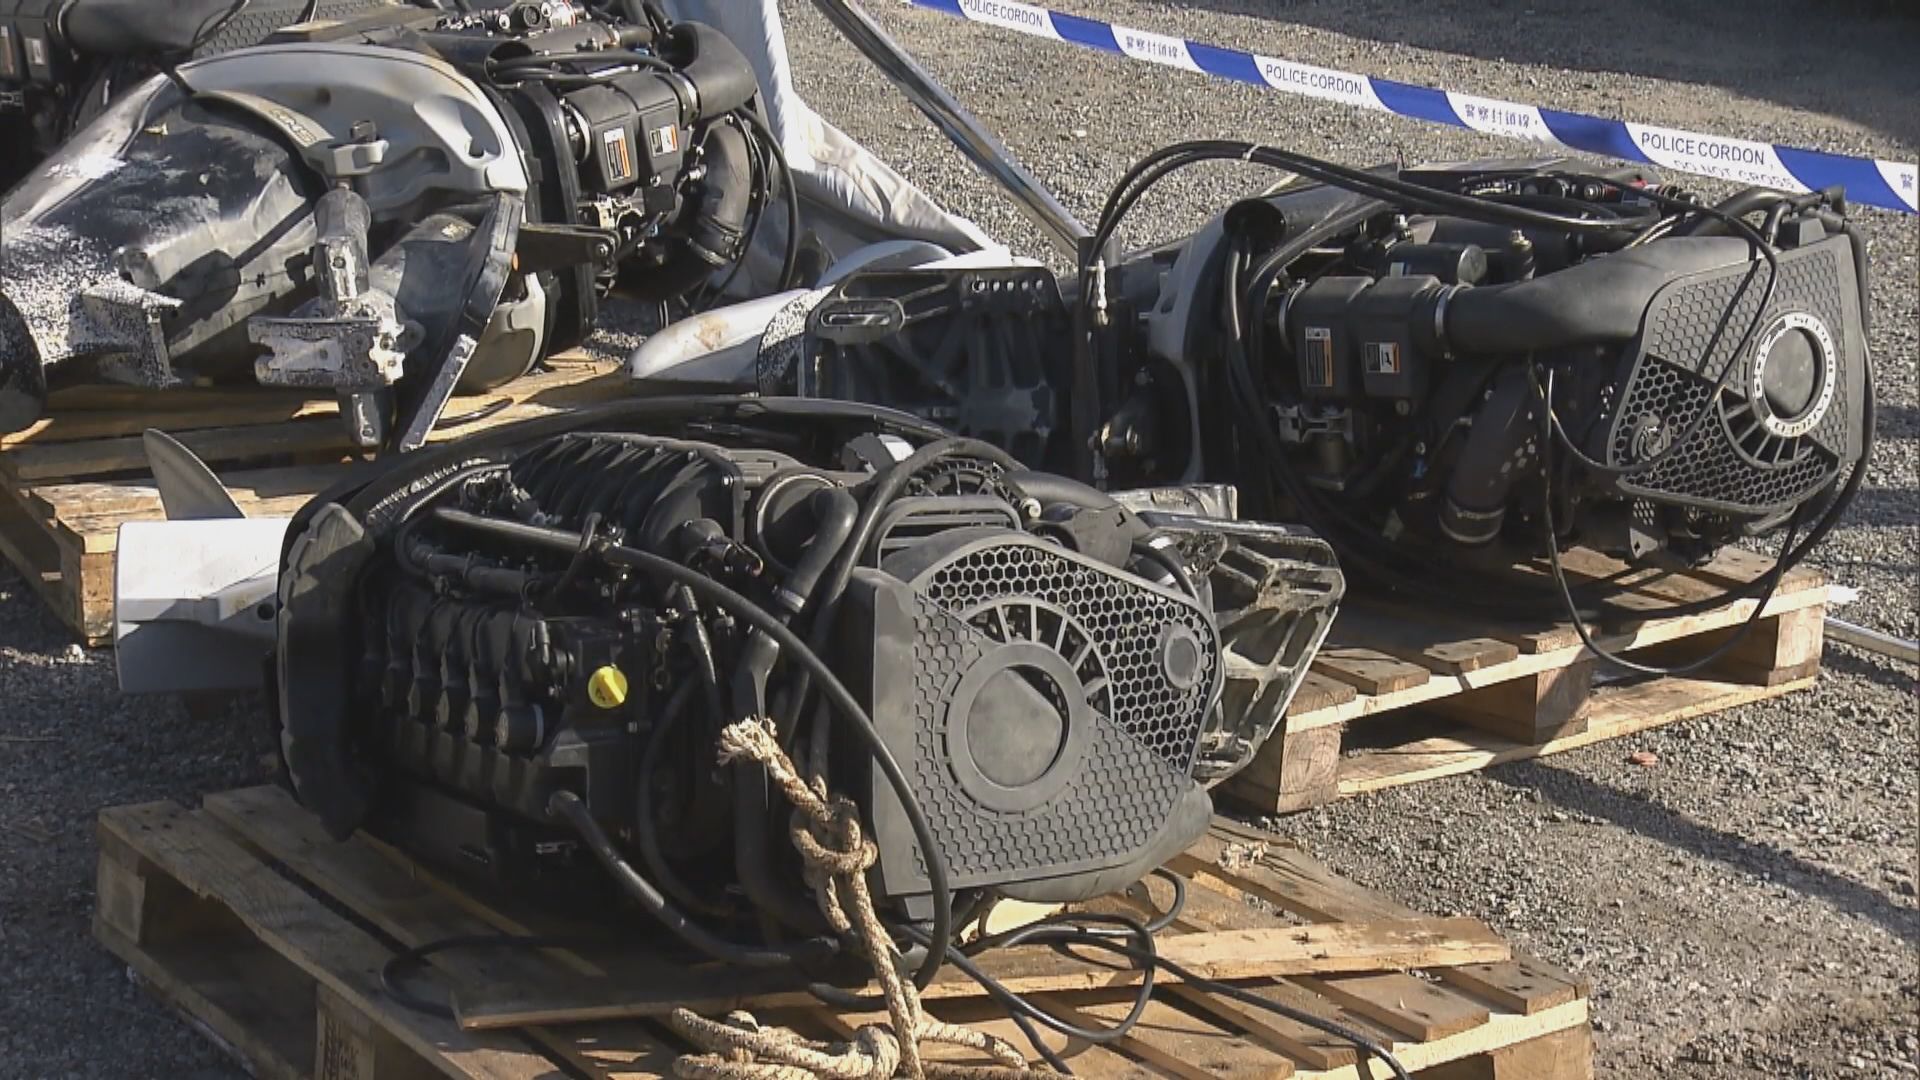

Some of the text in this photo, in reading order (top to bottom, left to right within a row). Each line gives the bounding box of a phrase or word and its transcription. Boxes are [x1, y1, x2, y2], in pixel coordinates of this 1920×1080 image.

[963, 0, 1043, 27] POLICE CORDON
[1266, 63, 1363, 95] POLICE CORDON
[1641, 132, 1765, 165] POLICE CORDON
